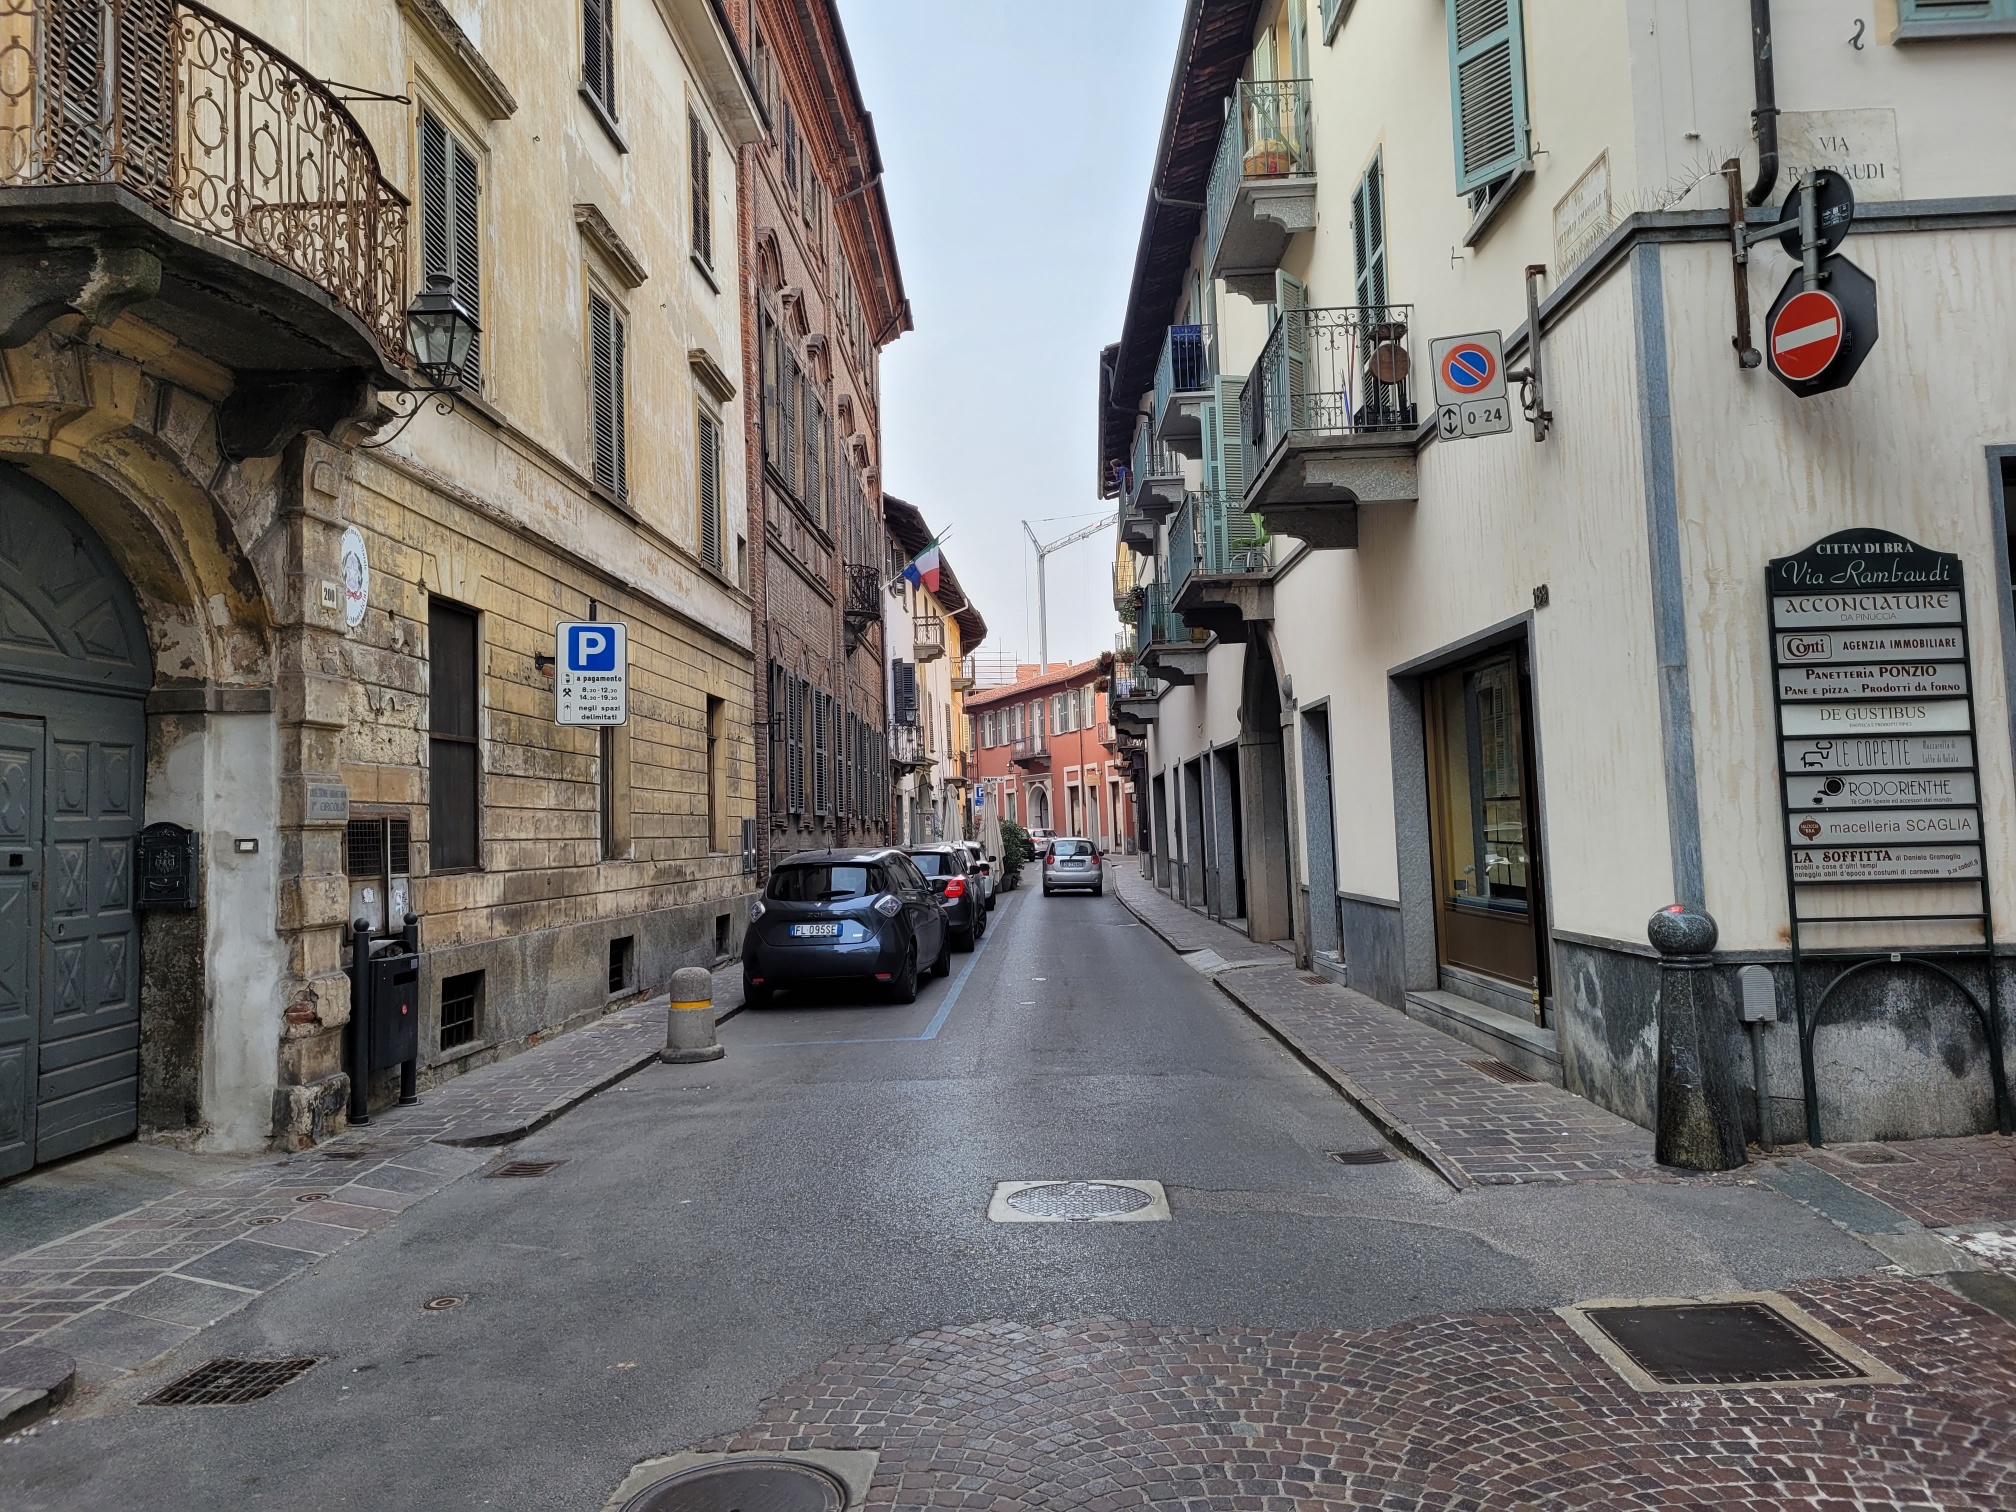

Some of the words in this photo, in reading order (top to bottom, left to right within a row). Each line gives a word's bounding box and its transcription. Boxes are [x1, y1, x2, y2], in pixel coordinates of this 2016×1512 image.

[1819, 137, 1849, 152] VIA
[1788, 163, 1885, 182] RAUDI
[1865, 543, 1881, 554] DI
[1884, 542, 1914, 553] BRA
[1782, 560, 1824, 585] Via
[1830, 557, 1950, 587] Rambaudi
[1785, 594, 1949, 613] ACCONCIATURE
[1840, 613, 1854, 622] DA
[1855, 612, 1897, 621] PINUCCIA
[578, 632, 607, 666] P
[1787, 638, 1826, 658] Conti
[1843, 640, 1886, 650] AGENZIA
[1890, 638, 1957, 649] IMMOBILIARE
[1879, 665, 1937, 678] PONZIO
[583, 675, 622, 684] pagamento
[1820, 709, 1841, 721] DE
[1846, 706, 1926, 720] GUSTIBUS
[1835, 741, 1850, 768] LE
[1856, 739, 1911, 767] COPETTE
[1848, 780, 1952, 796] RODORIENTHE
[1830, 820, 1900, 834] macelleria
[1906, 818, 1972, 831] SCAGLIA
[1793, 852, 1813, 863] LA
[1822, 850, 1893, 863] SOFFITTA
[1873, 868, 1899, 876] costumi
